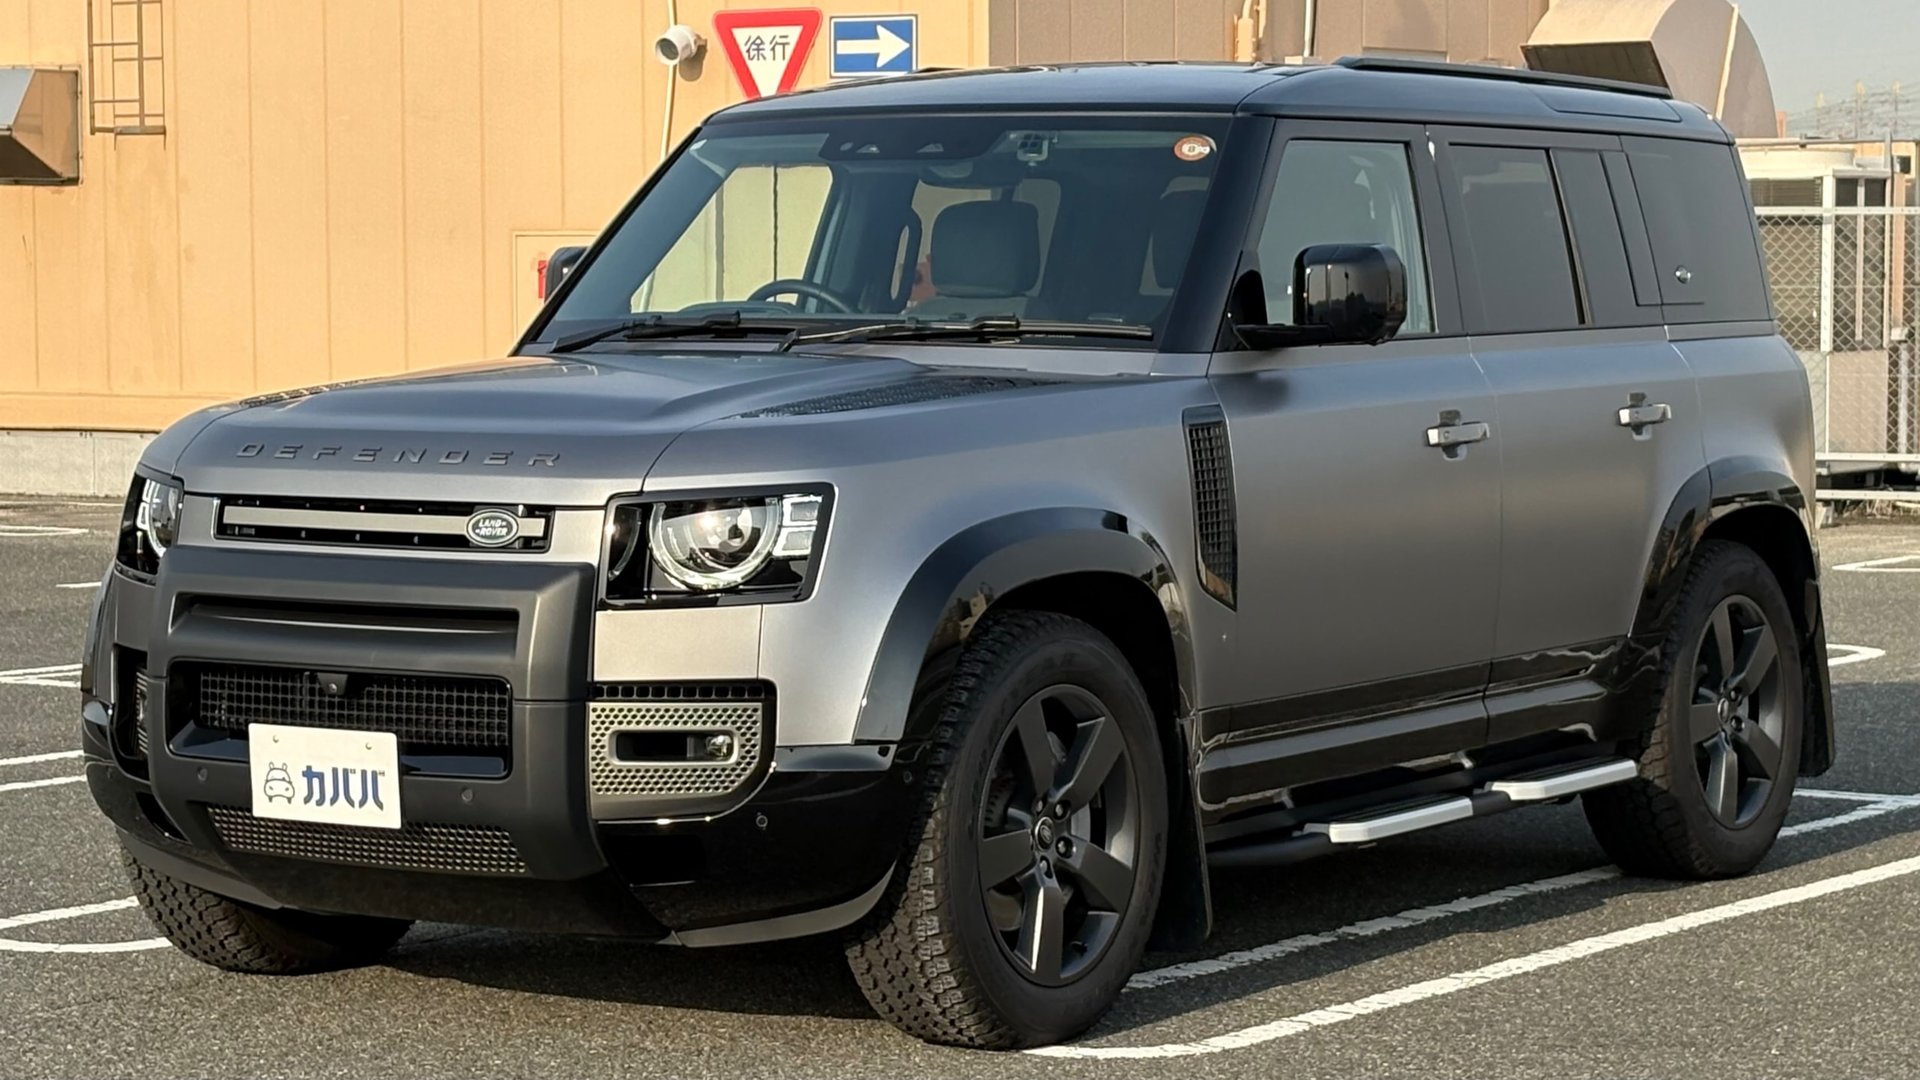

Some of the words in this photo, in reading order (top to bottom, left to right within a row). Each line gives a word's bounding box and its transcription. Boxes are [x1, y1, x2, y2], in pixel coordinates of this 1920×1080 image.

[744, 35, 790, 61] 徐行
[236, 443, 560, 467] DEFENDER
[302, 765, 385, 812] カババ
